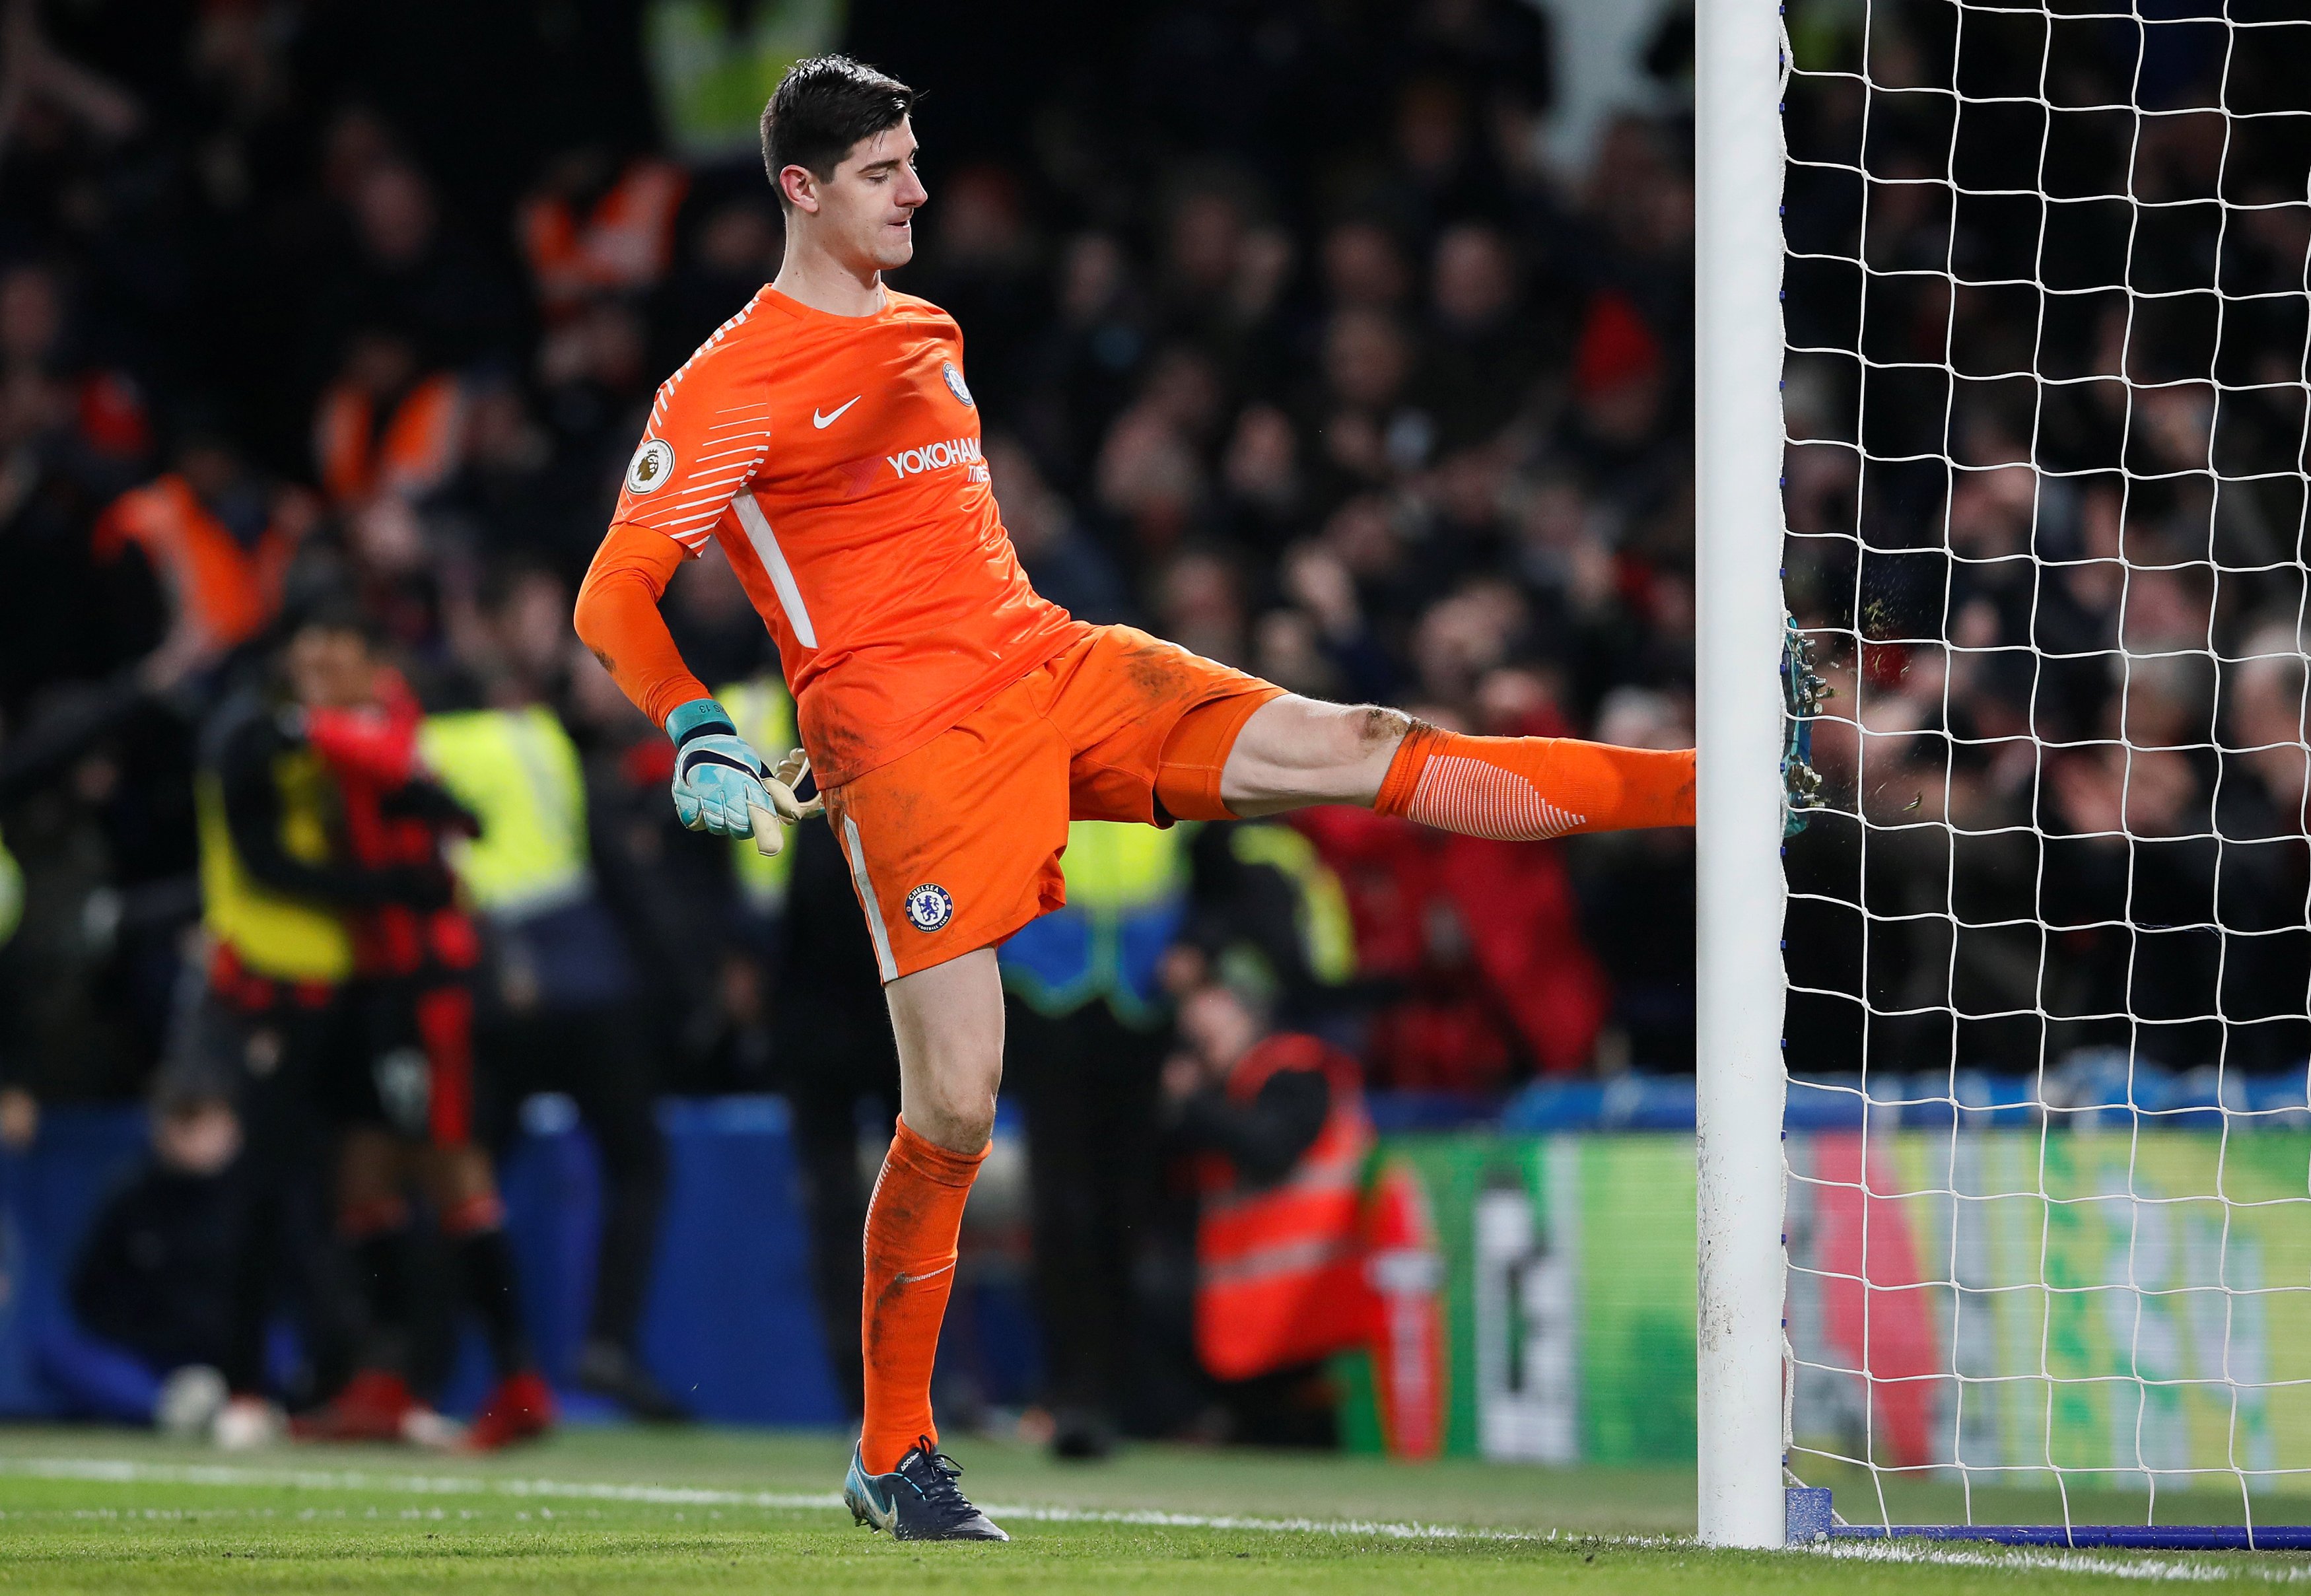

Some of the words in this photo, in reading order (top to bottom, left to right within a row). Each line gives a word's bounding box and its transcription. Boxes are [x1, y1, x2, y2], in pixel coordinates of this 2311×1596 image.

[699, 703, 711, 713] 13
[909, 885, 939, 900] CHELSEA
[939, 916, 948, 926] CLUB
